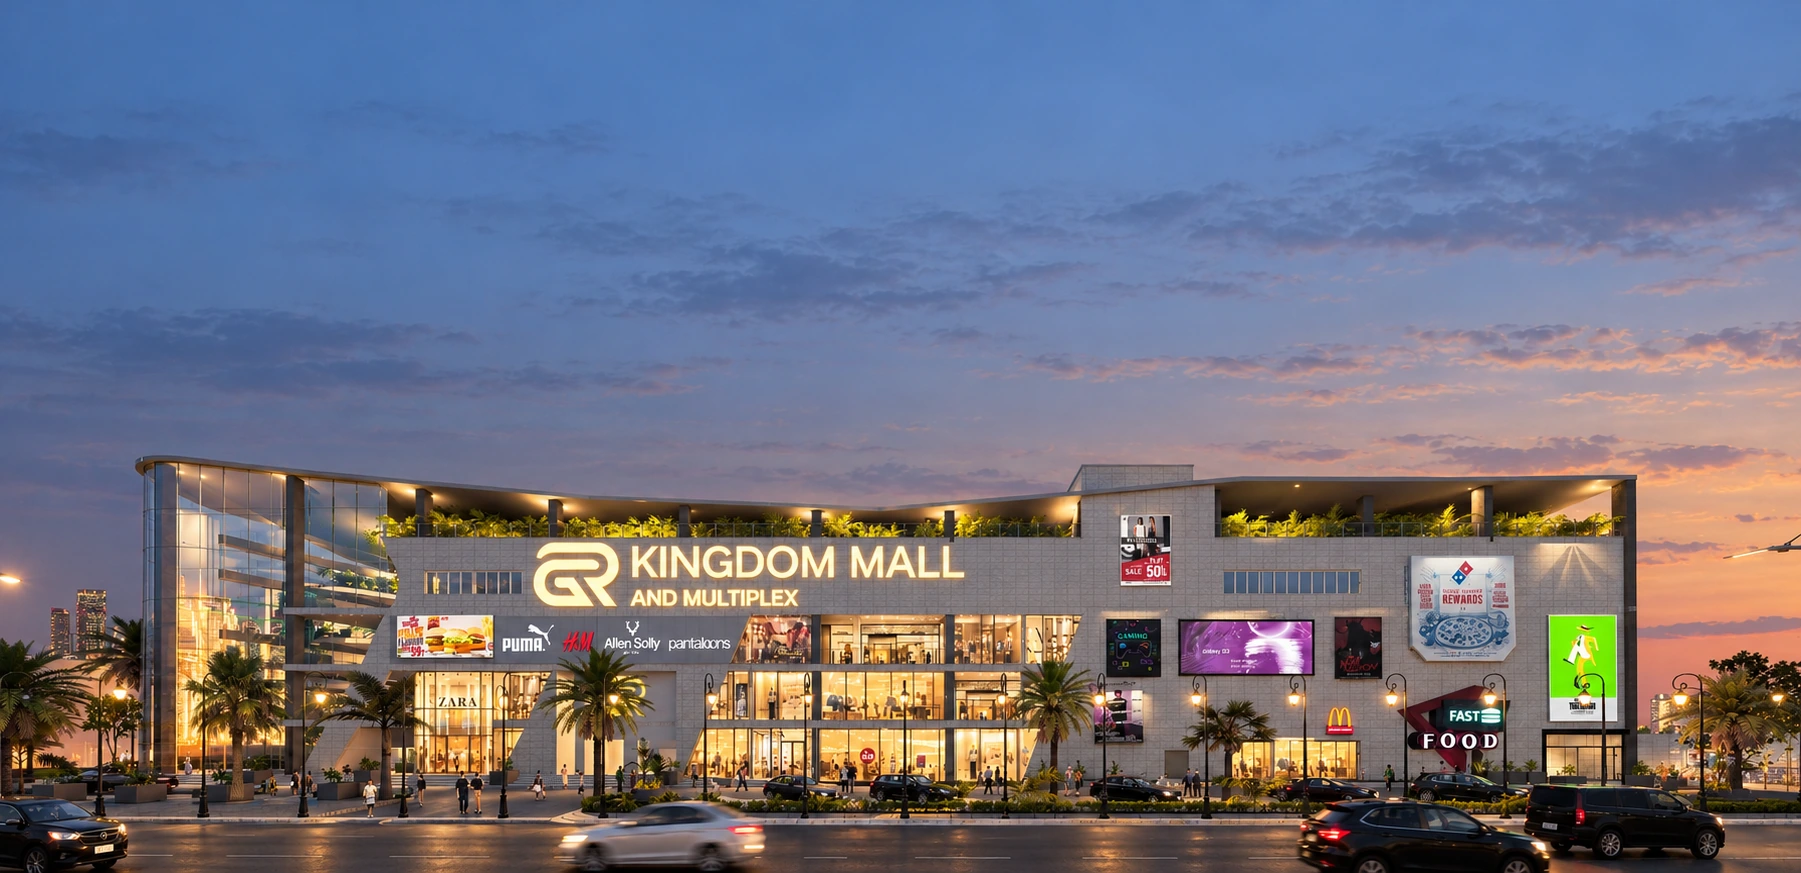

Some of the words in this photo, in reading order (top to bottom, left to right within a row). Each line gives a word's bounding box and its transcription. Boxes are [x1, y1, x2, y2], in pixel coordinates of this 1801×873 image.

[631, 545, 835, 579] KINGDOM
[850, 545, 965, 578] MALL
[630, 589, 677, 607] AND
[682, 589, 799, 607] MULTIPLEX
[1442, 594, 1483, 605] REWARDS
[604, 637, 631, 649] Allen
[633, 637, 661, 652] Solly
[668, 637, 731, 652] pantaloons
[438, 696, 478, 707] ZARA
[1449, 710, 1480, 722] FAST
[1423, 732, 1498, 750] FOOD
